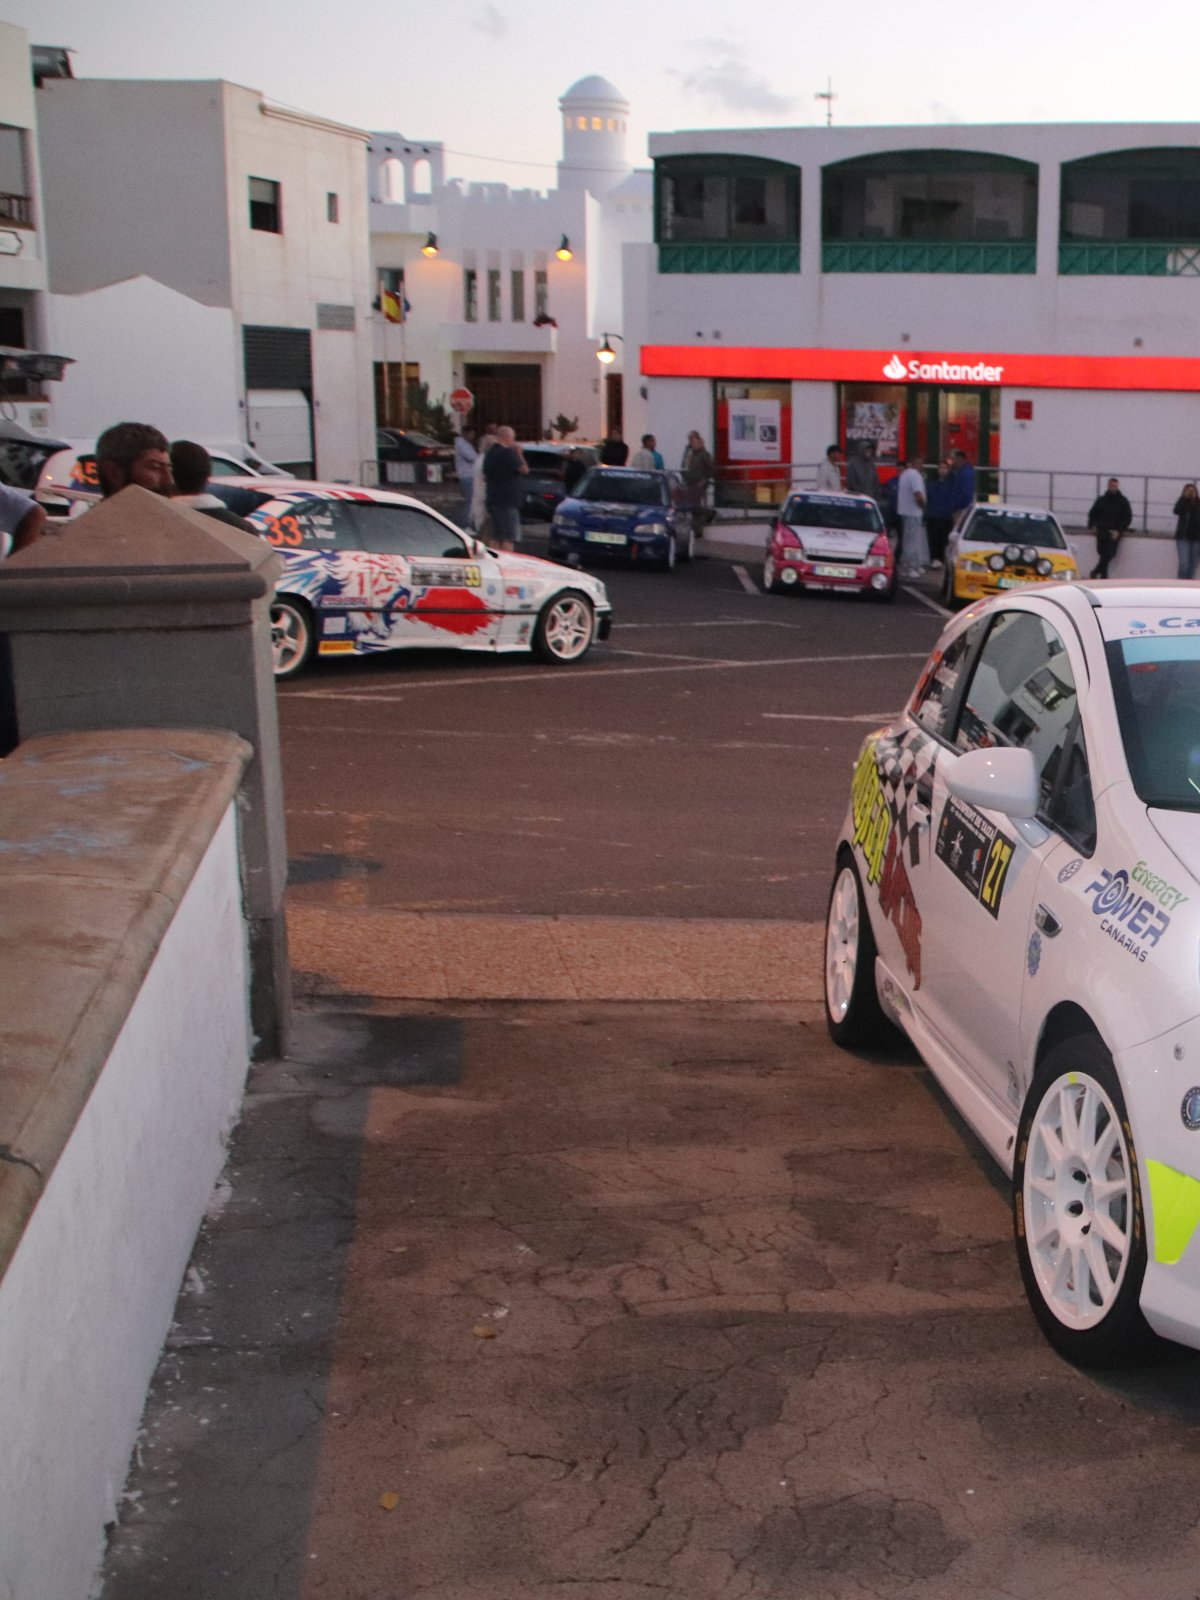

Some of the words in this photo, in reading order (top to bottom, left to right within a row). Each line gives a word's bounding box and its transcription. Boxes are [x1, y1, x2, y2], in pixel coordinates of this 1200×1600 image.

[908, 360, 1004, 382] Santander
[264, 515, 304, 545] 33
[982, 838, 1011, 908] 27
[1131, 861, 1189, 911] ENERGY
[1084, 868, 1170, 947] POWER
[1100, 919, 1149, 962] CANARIAS
